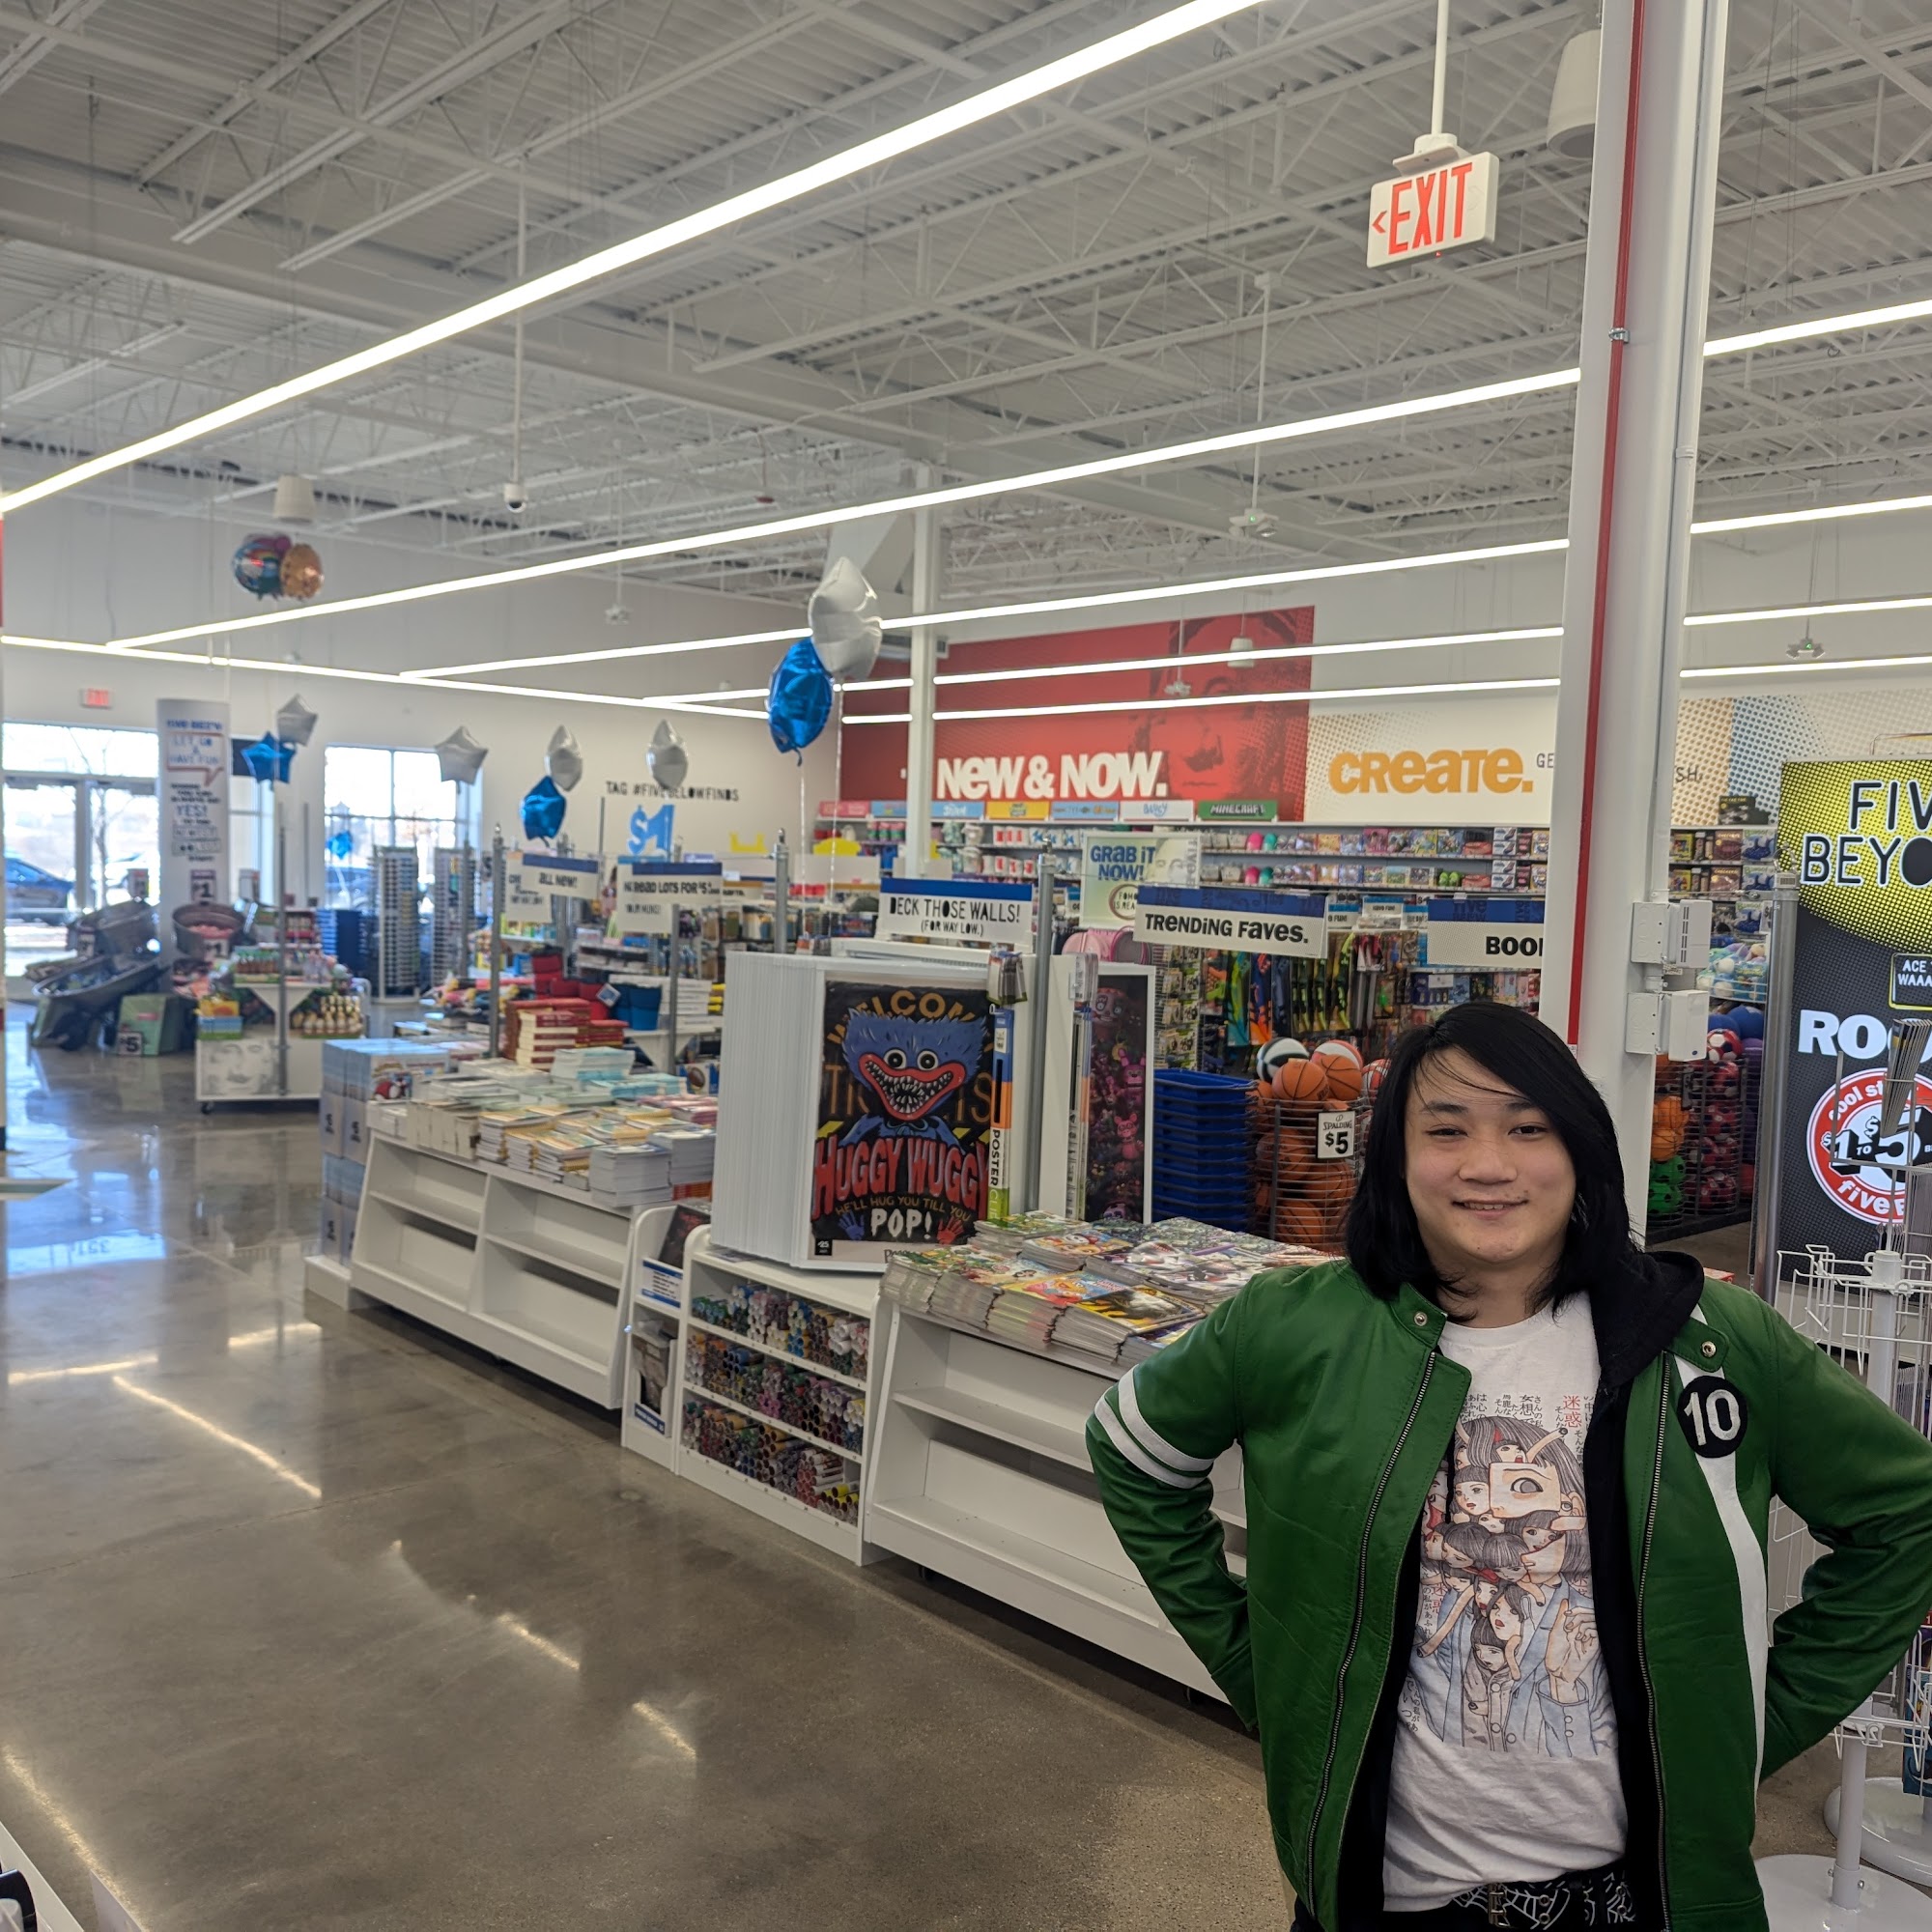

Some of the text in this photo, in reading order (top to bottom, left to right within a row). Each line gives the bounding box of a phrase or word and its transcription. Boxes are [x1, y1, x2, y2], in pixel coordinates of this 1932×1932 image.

[1388, 162, 1472, 255] EXIT
[606, 781, 628, 796] TAG
[1024, 754, 1055, 799] &
[1061, 751, 1168, 798] NOW.
[1209, 804, 1265, 817] MINECRAFT
[1848, 780, 1932, 832] FIV
[1097, 864, 1145, 881] NOW!
[1801, 833, 1932, 888] BEYO
[659, 882, 678, 894] LOTS
[681, 882, 697, 894] FOR
[890, 896, 1021, 923] DECK THOSE WALLS!
[921, 920, 983, 937] (FOR WAY LOW.)
[1902, 959, 1927, 973] ACE
[1323, 1122, 1352, 1131] SPALDING
[1324, 1131, 1349, 1154] $5
[1857, 1146, 1872, 1155] TO
[990, 1128, 1001, 1186] POSTER
[811, 1134, 988, 1221] HUGGY WUGGY
[835, 1195, 971, 1222] HE'LL HUG YOU TILL YOU
[1837, 1179, 1890, 1214] five
[870, 1208, 932, 1239] POP!
[1563, 1396, 1581, 1428] 迷惑
[1684, 1389, 1741, 1446] 10
